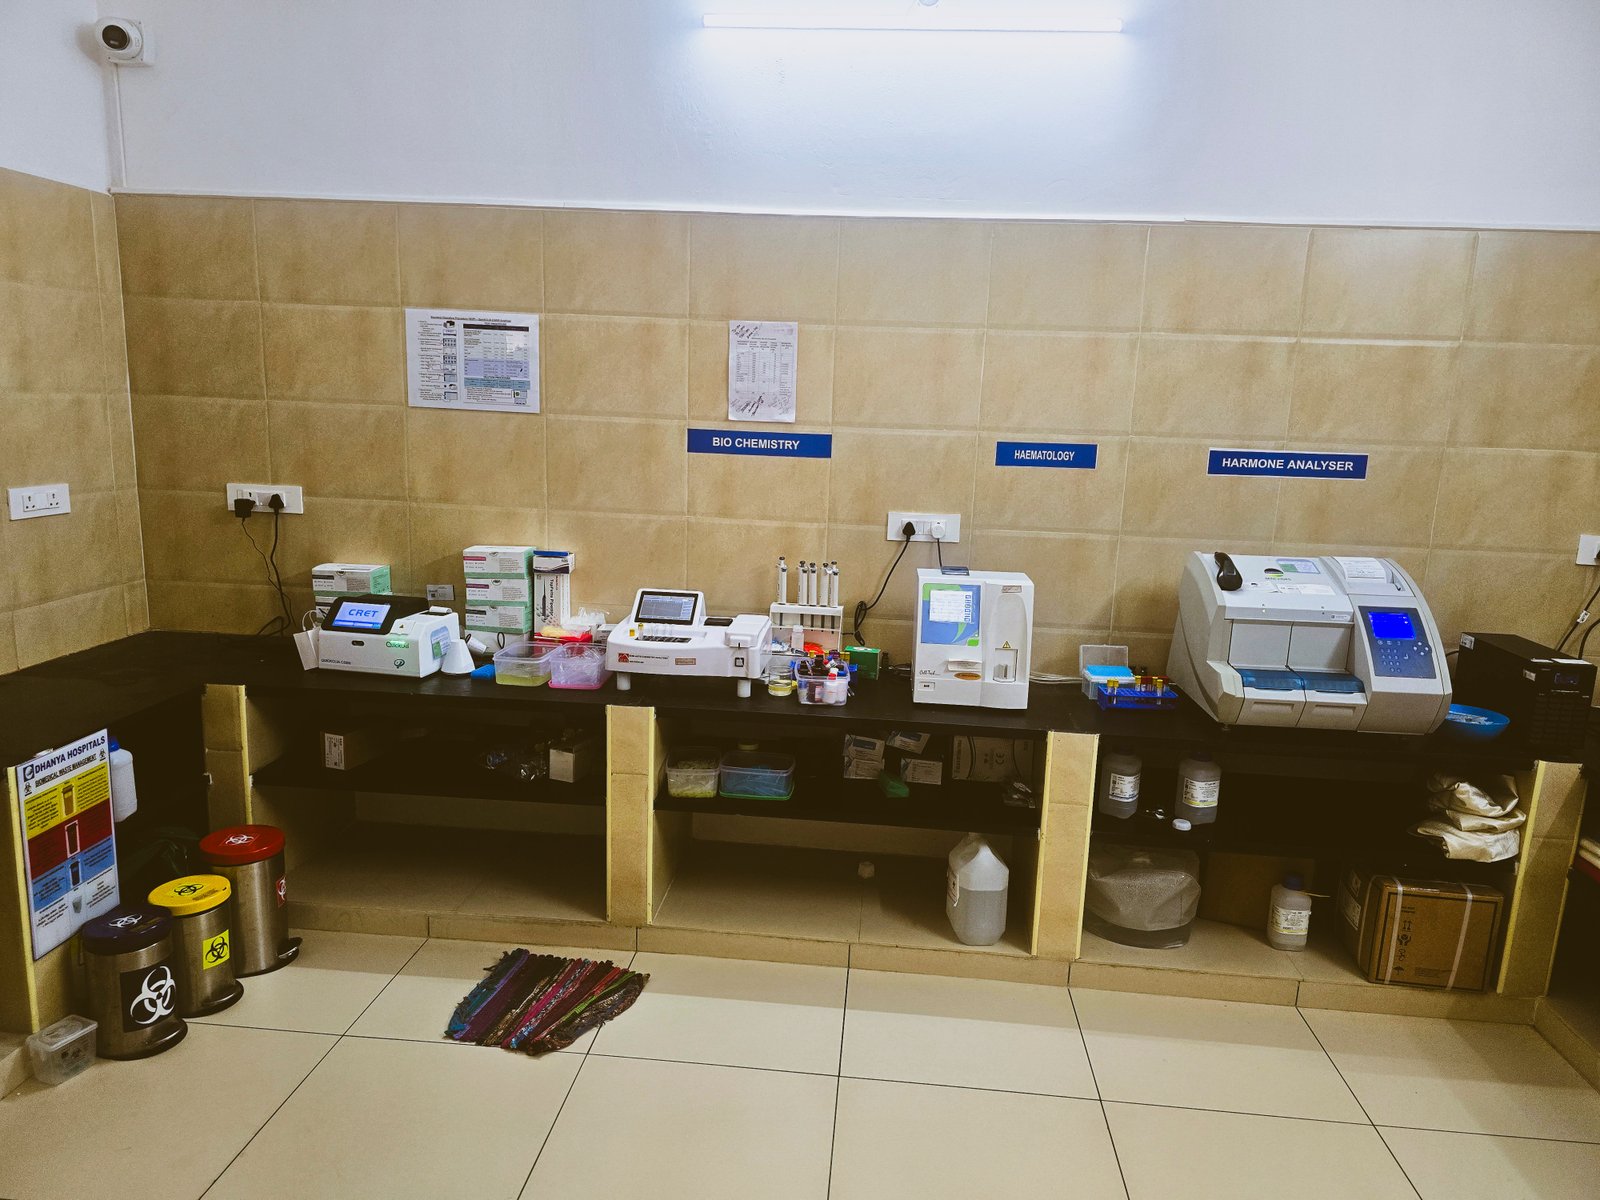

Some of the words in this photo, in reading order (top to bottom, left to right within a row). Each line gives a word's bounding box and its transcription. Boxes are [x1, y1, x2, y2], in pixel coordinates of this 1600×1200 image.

[712, 437, 732, 447] BIO
[735, 438, 800, 450] CHEMISTRY
[1014, 450, 1075, 461] HAEMATOLOGY
[1222, 458, 1285, 469] HARMONE
[1286, 460, 1354, 471] ANALYSER
[348, 608, 379, 618] CRET
[34, 753, 66, 774] DHANYA
[67, 736, 106, 760] HOSPITALS
[35, 771, 58, 788] BIOMEDICAL
[59, 764, 72, 776] WASTE
[72, 753, 97, 770] MANAGEMENT
